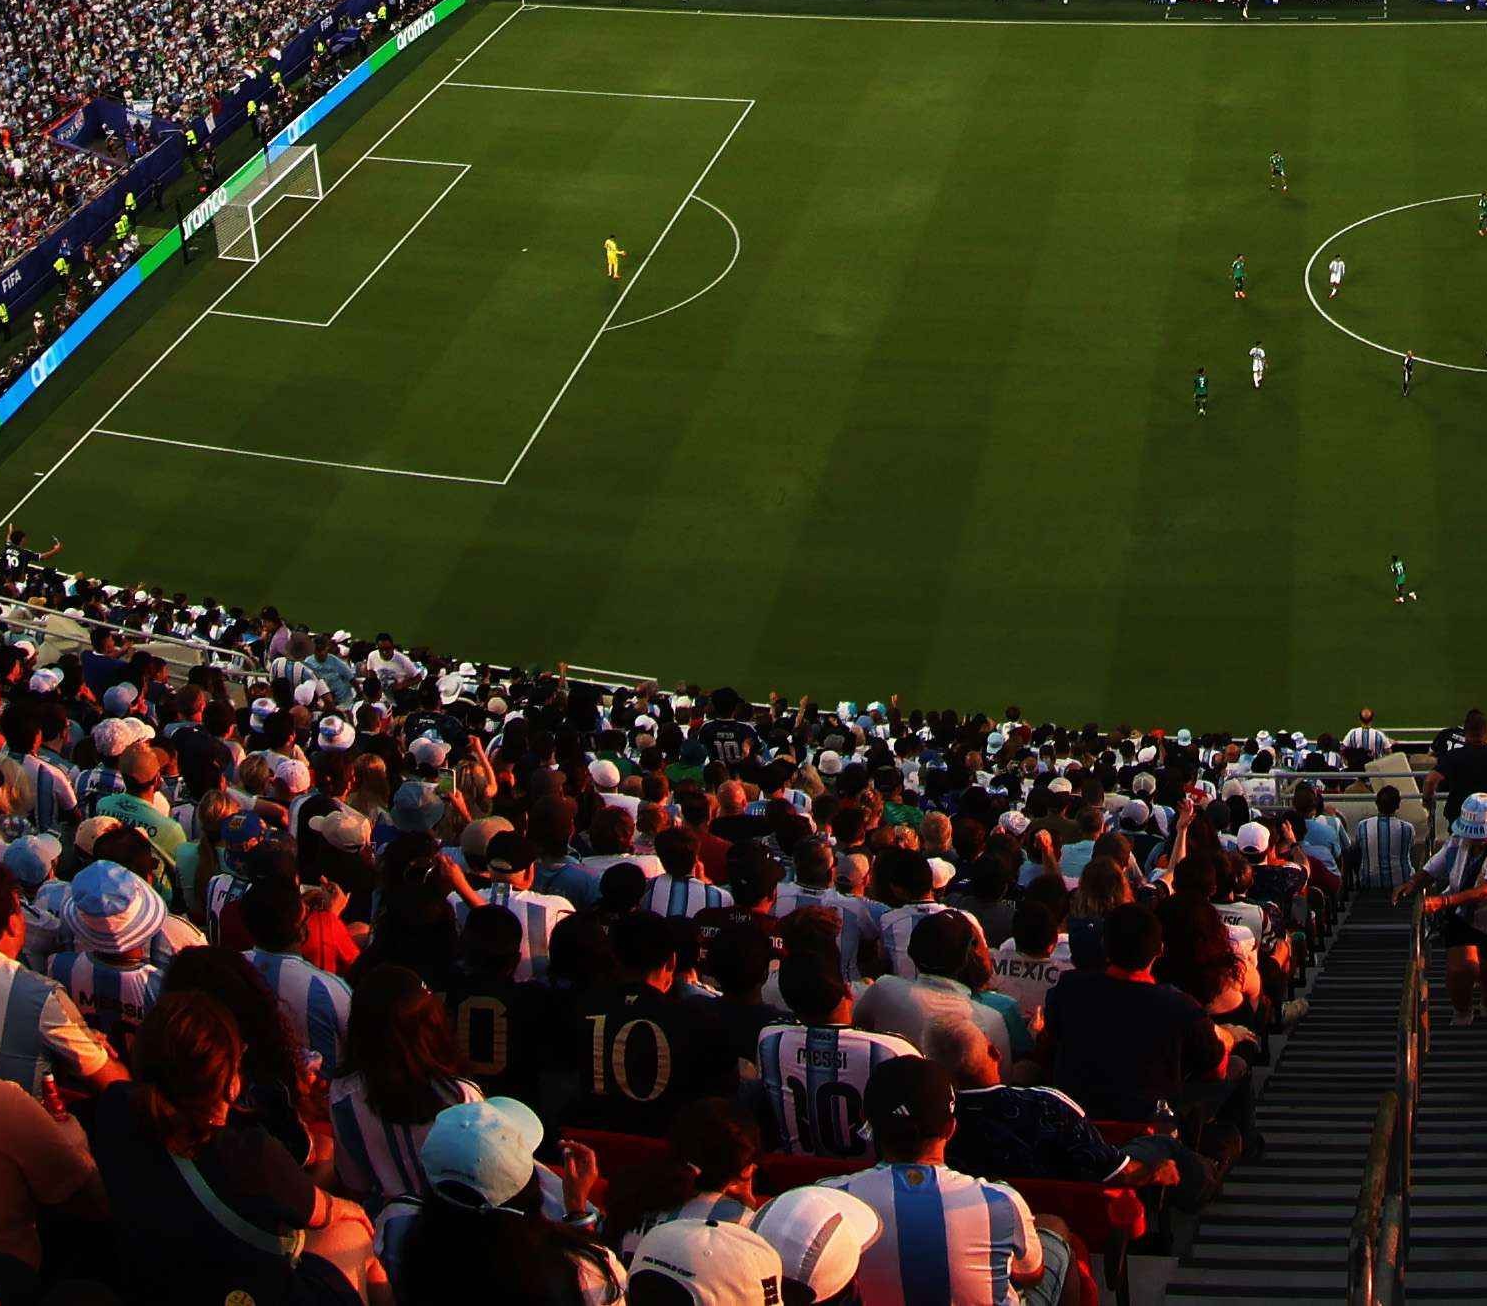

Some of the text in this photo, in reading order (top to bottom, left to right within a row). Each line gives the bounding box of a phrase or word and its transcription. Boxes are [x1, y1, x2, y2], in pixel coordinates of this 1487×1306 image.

[396, 10, 436, 51] aramco
[2, 265, 22, 289] FIFA
[993, 960, 1060, 983] MEXIC
[586, 1013, 672, 1101] 10
[796, 1048, 847, 1070] MESSI
[787, 1076, 865, 1155] 10
